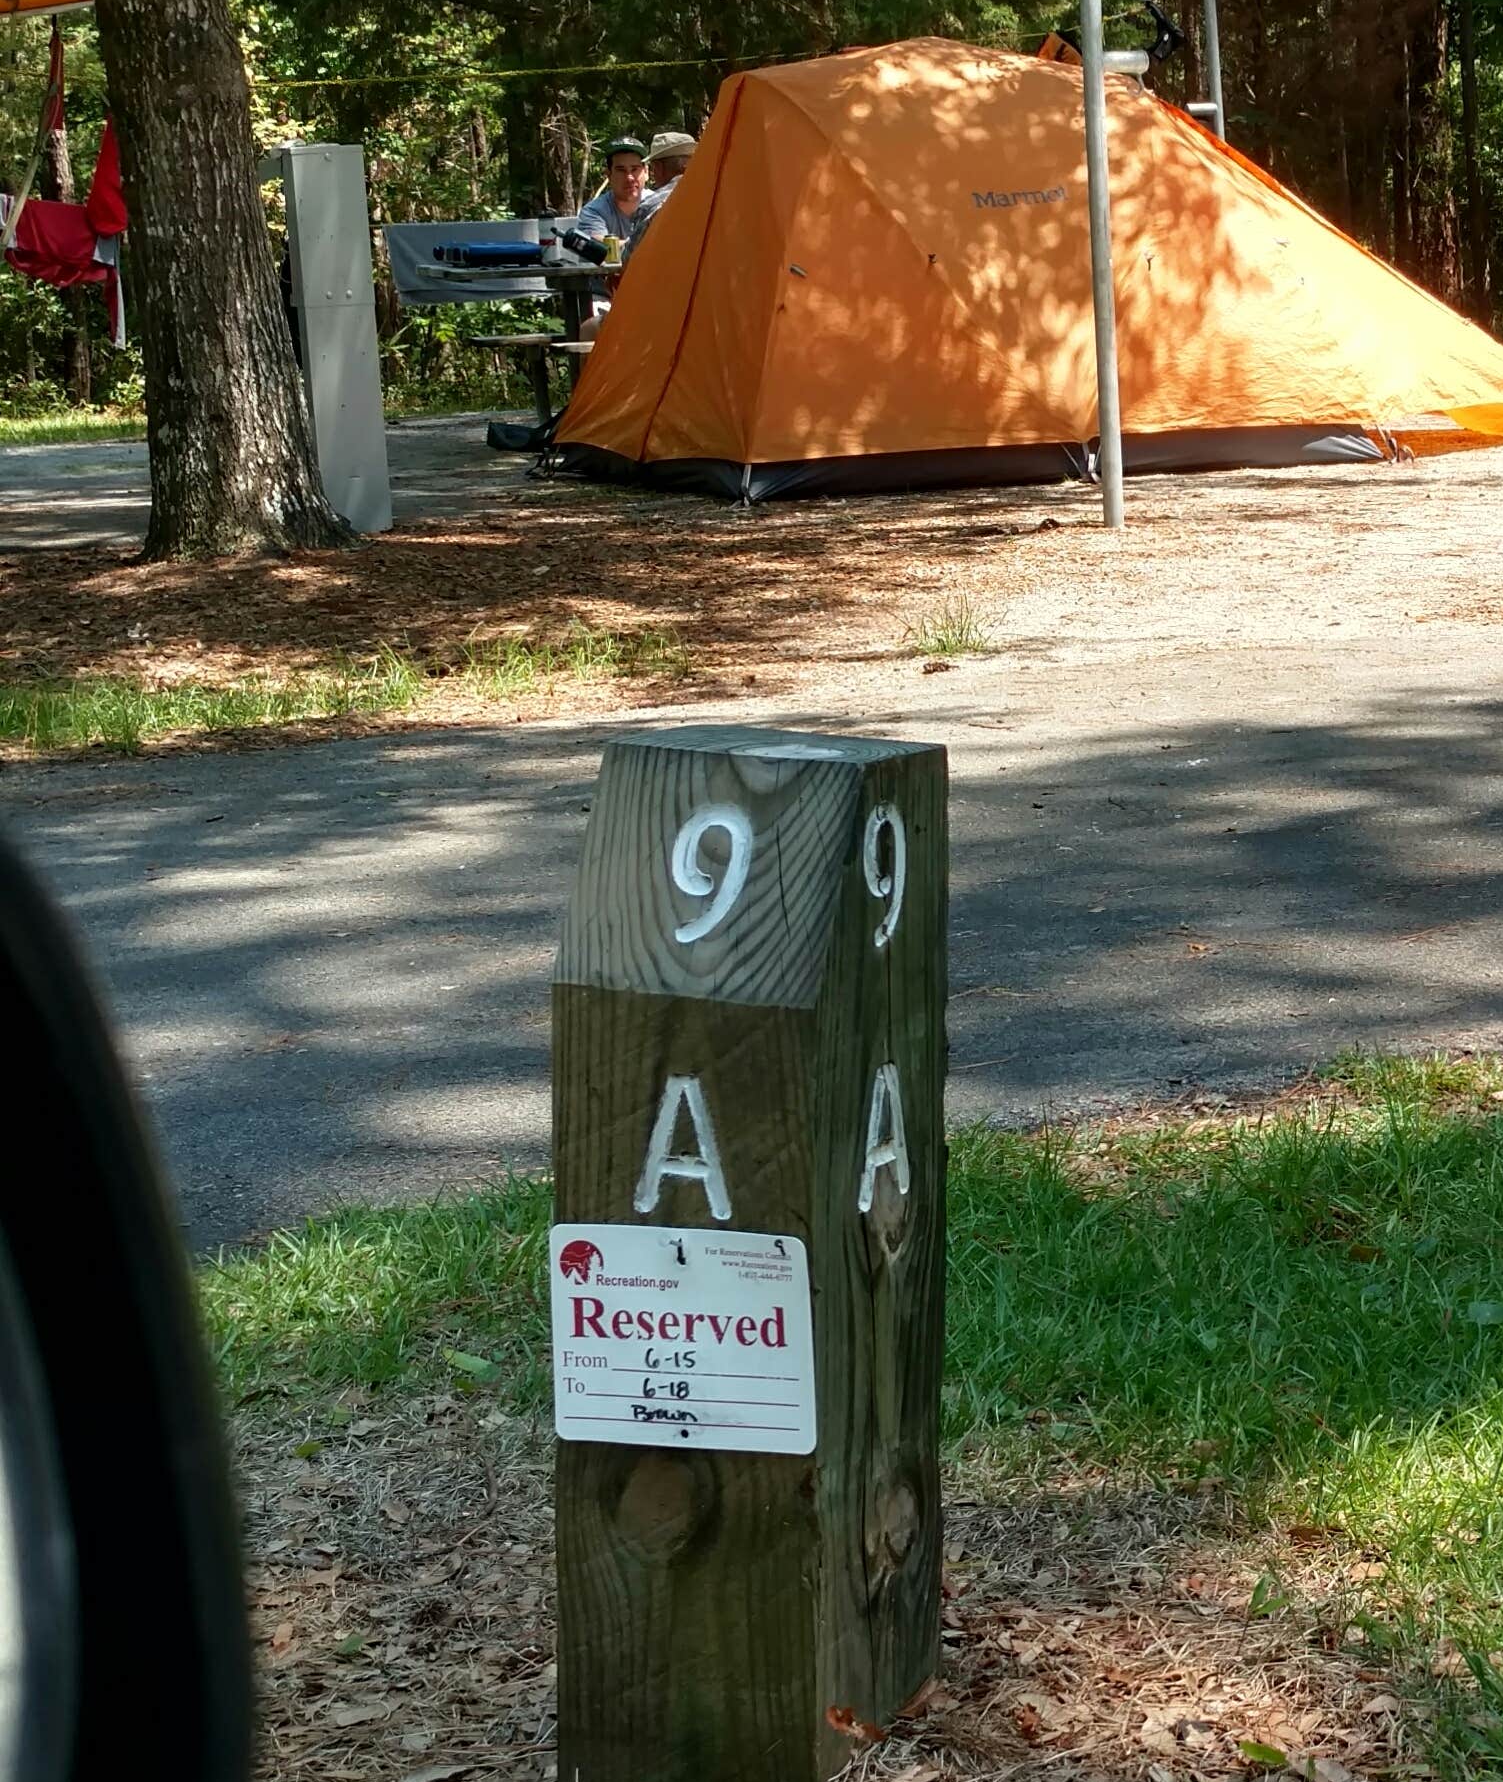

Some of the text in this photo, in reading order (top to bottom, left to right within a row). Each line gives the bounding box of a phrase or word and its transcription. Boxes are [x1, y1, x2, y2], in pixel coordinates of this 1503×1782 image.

[672, 803, 753, 944] 9
[863, 802, 907, 948] 9
[633, 1074, 732, 1220] A
[857, 1061, 910, 1213] A
[595, 1274, 679, 1291] Recreation.gov
[568, 1296, 788, 1348] Reserved
[563, 1351, 608, 1368] From
[644, 1347, 697, 1369] 6-15
[563, 1377, 586, 1394] To
[642, 1377, 690, 1400] 6-18
